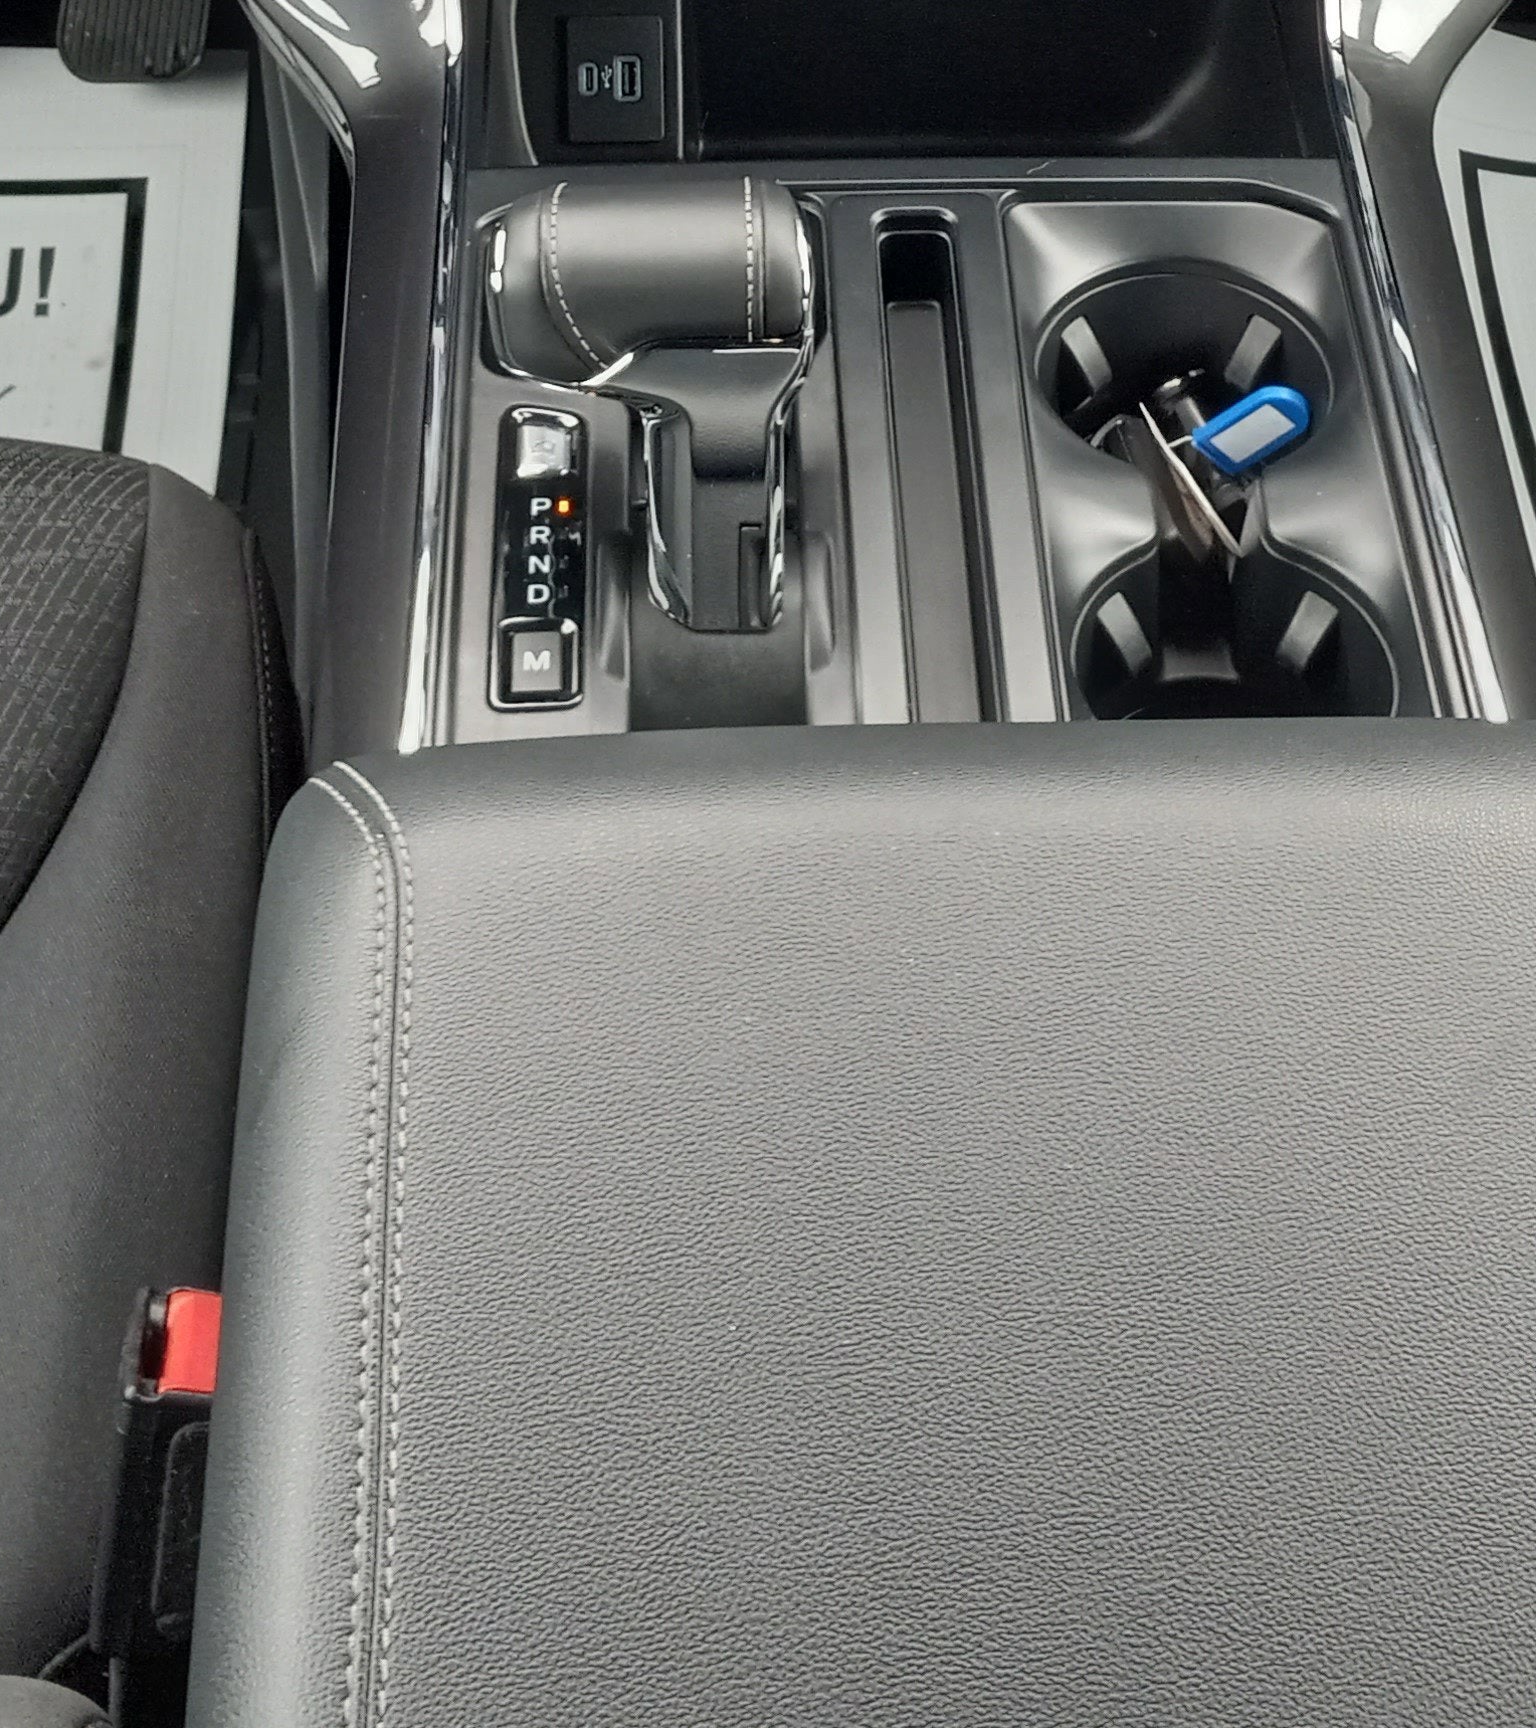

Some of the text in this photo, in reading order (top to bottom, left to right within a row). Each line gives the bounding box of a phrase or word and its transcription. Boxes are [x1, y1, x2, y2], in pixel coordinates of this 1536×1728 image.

[530, 497, 552, 516] P
[529, 525, 551, 544] R
[528, 555, 551, 574] N
[526, 584, 551, 604] D
[522, 650, 551, 671] M
